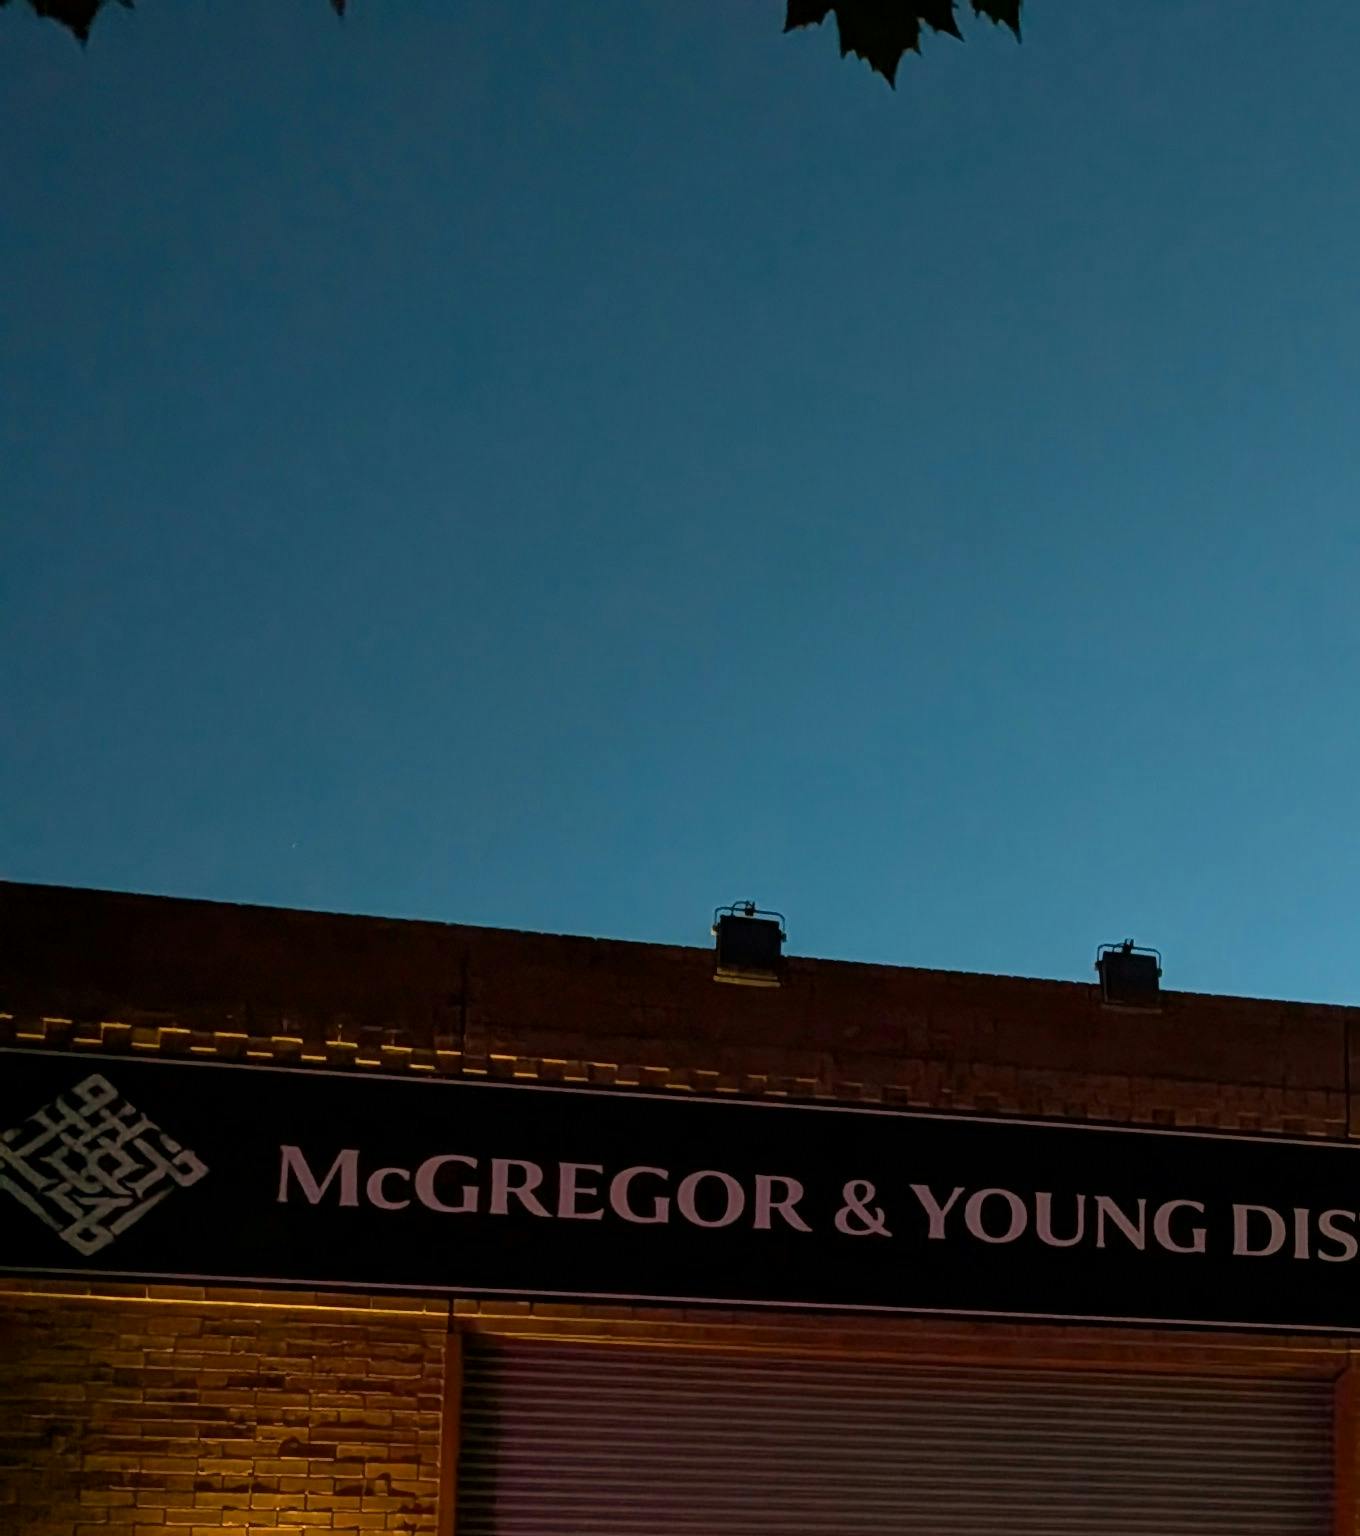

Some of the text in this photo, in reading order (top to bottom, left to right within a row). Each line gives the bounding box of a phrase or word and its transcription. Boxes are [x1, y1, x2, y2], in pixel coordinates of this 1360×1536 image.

[275, 1143, 814, 1234] McGREGOR
[834, 1178, 893, 1238] &
[908, 1183, 1207, 1254] YOUNG
